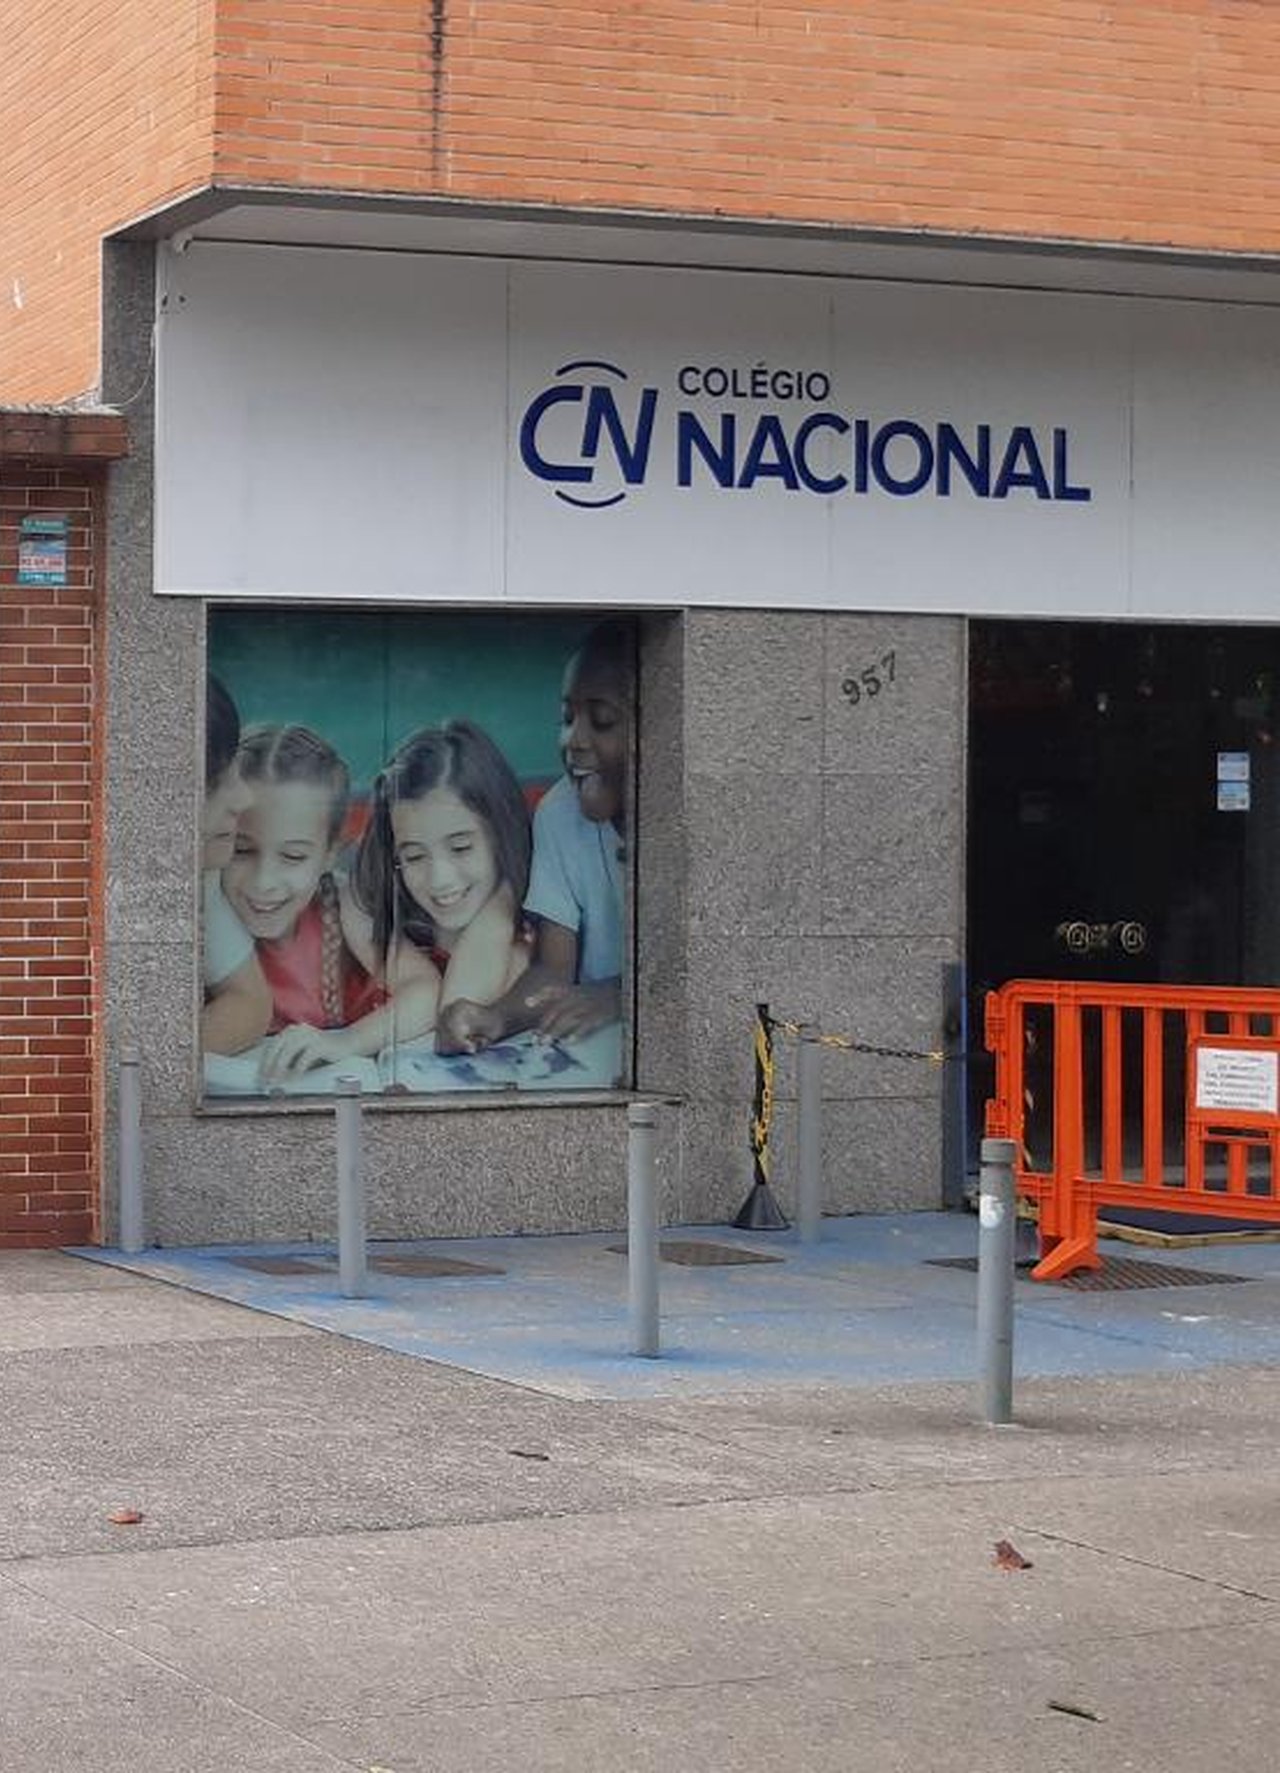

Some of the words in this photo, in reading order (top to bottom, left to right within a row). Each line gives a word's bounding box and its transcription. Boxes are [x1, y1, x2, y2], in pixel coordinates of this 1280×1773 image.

[678, 361, 830, 402] COLÉGIO
[519, 384, 659, 485] CN
[677, 411, 1092, 502] NACIONAL
[842, 650, 896, 706] 957
